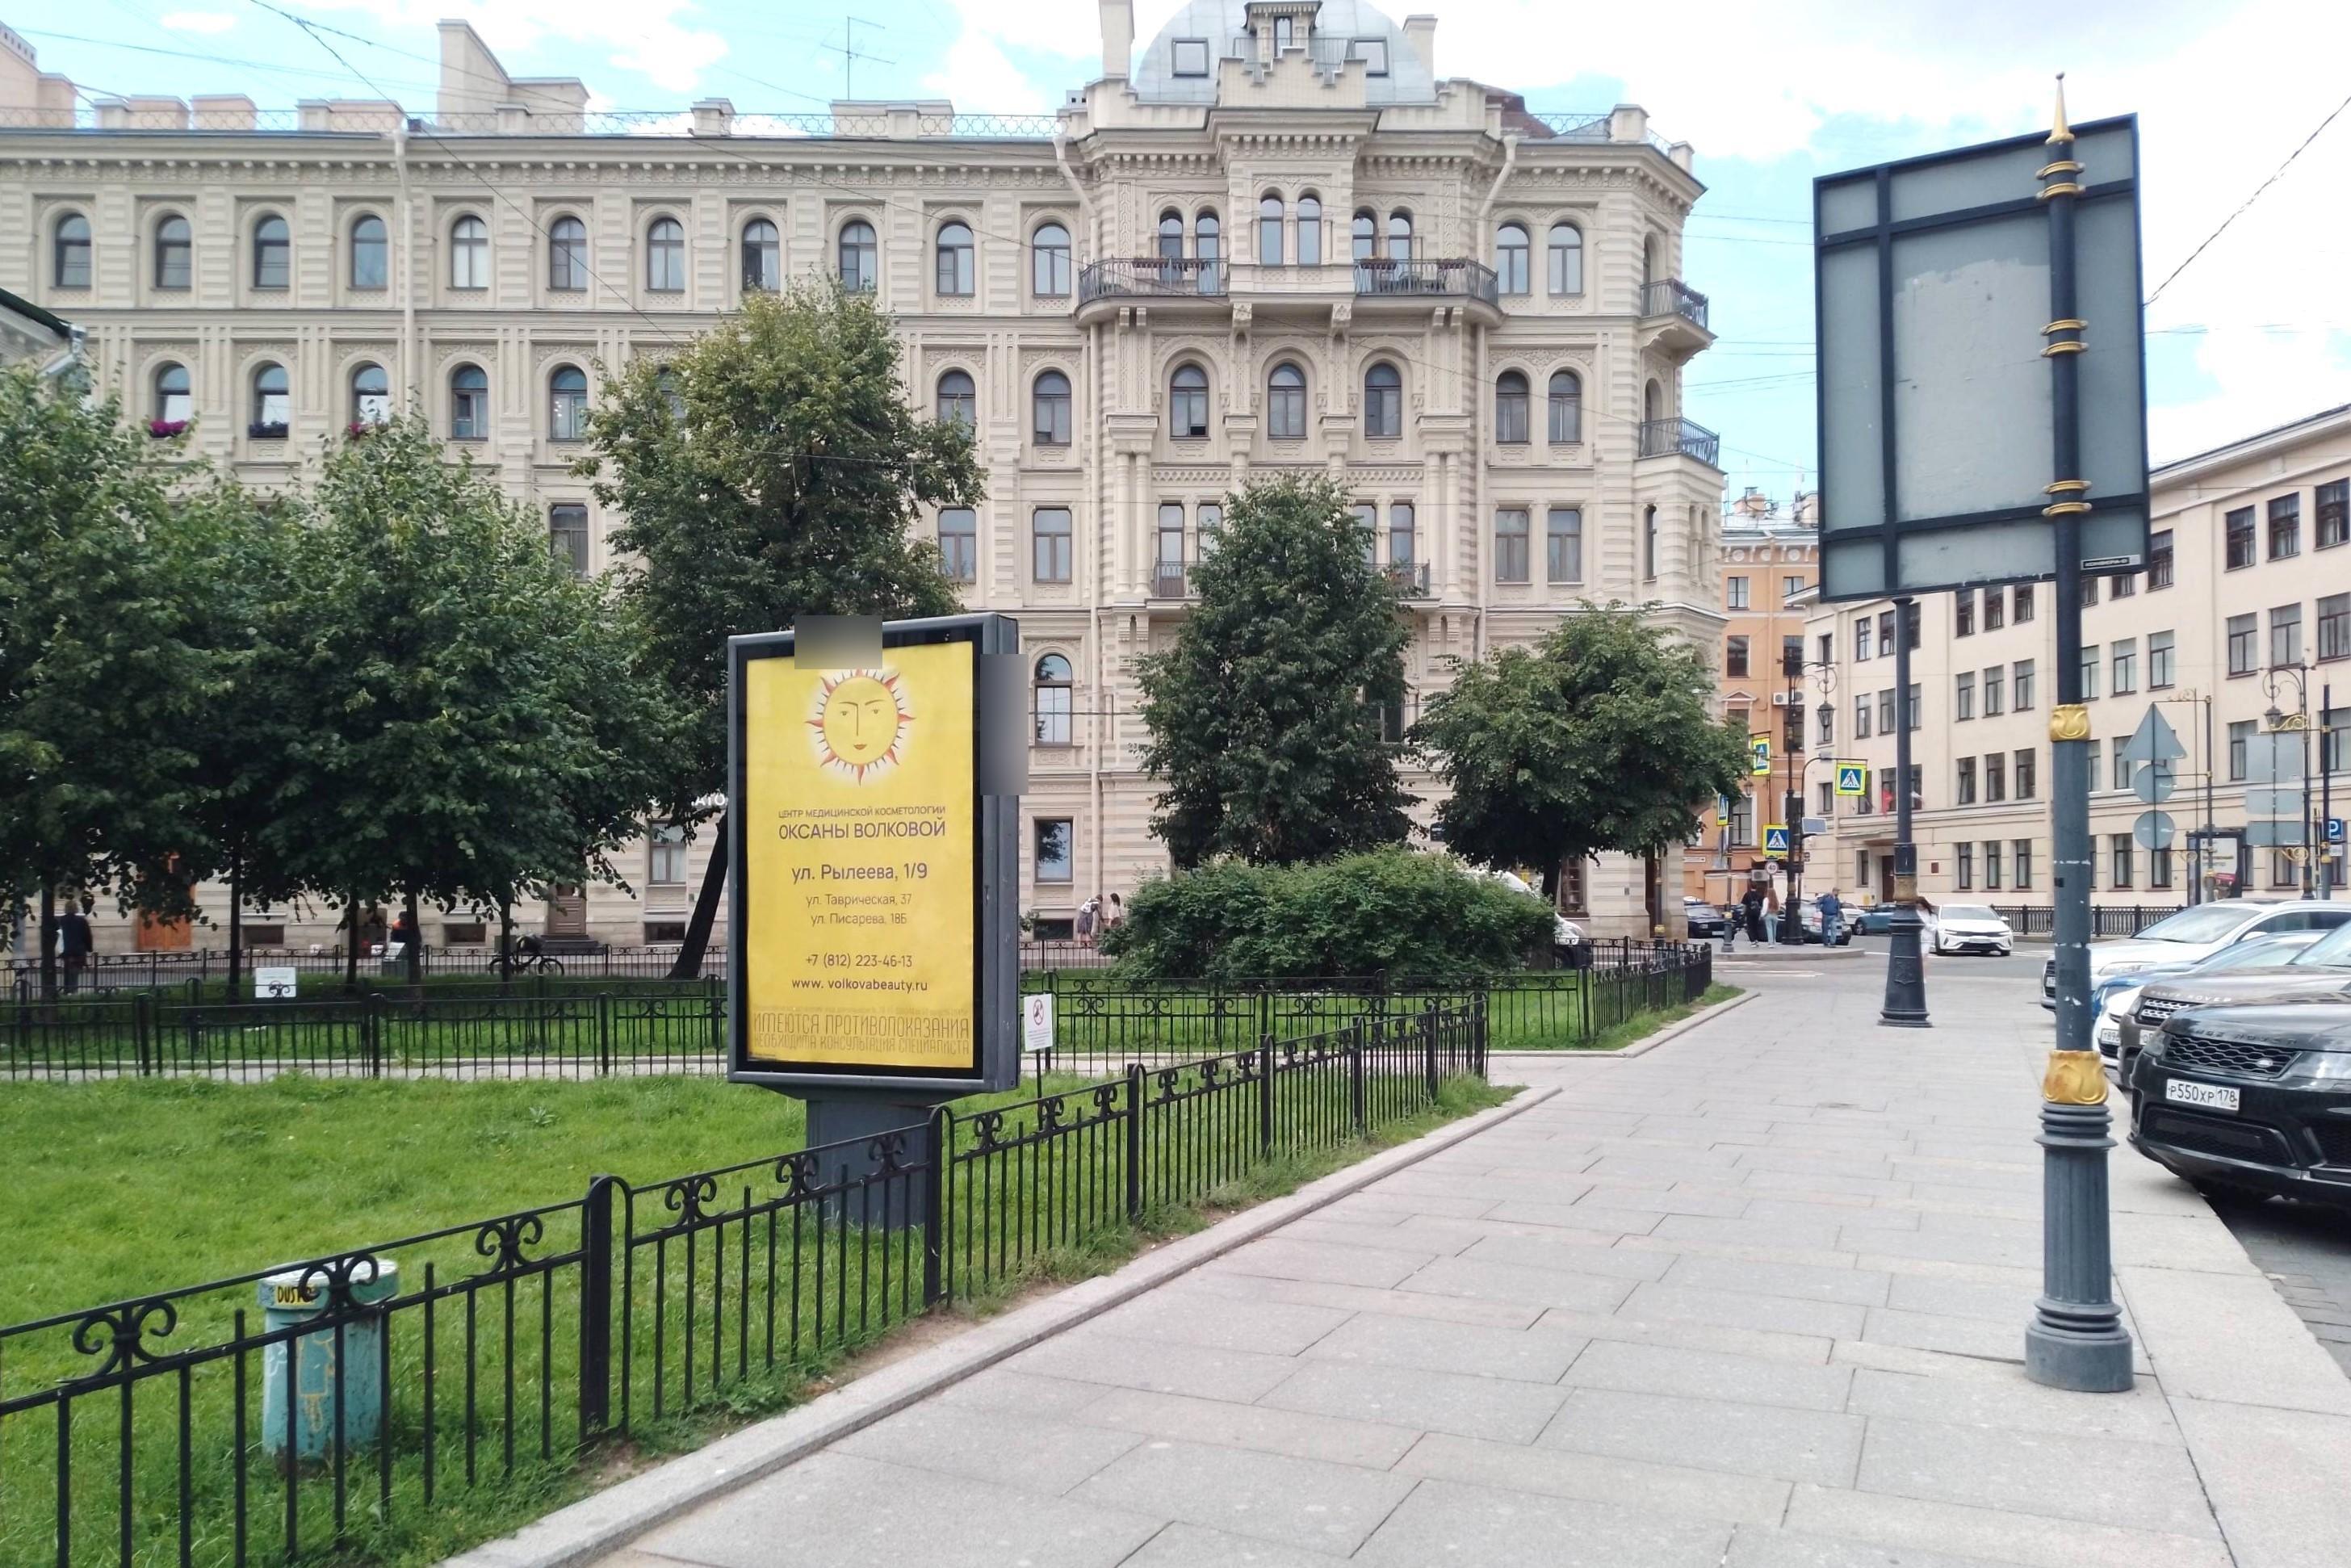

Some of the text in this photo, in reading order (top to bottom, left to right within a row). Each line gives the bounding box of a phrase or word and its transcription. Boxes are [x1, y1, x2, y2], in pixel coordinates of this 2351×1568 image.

[778, 805, 945, 818] ЦЕНТР МЕДИЦИНСКОЙ КОСМЕТОЛОГИИ
[779, 817, 945, 839] ОКСАНЫ ВОЛКОВОЙ
[791, 862, 928, 884] ул. Рылеева, 1/9
[806, 893, 912, 908] ул. Таврическая, 37
[811, 915, 826, 928] ул.
[806, 953, 913, 969] +7 (812) 223-46-13
[753, 1012, 969, 1039] ИМЕЮТСЯ ПРОТИВОПОКАЗАНИЯ
[2218, 1089, 2236, 1102] 178
